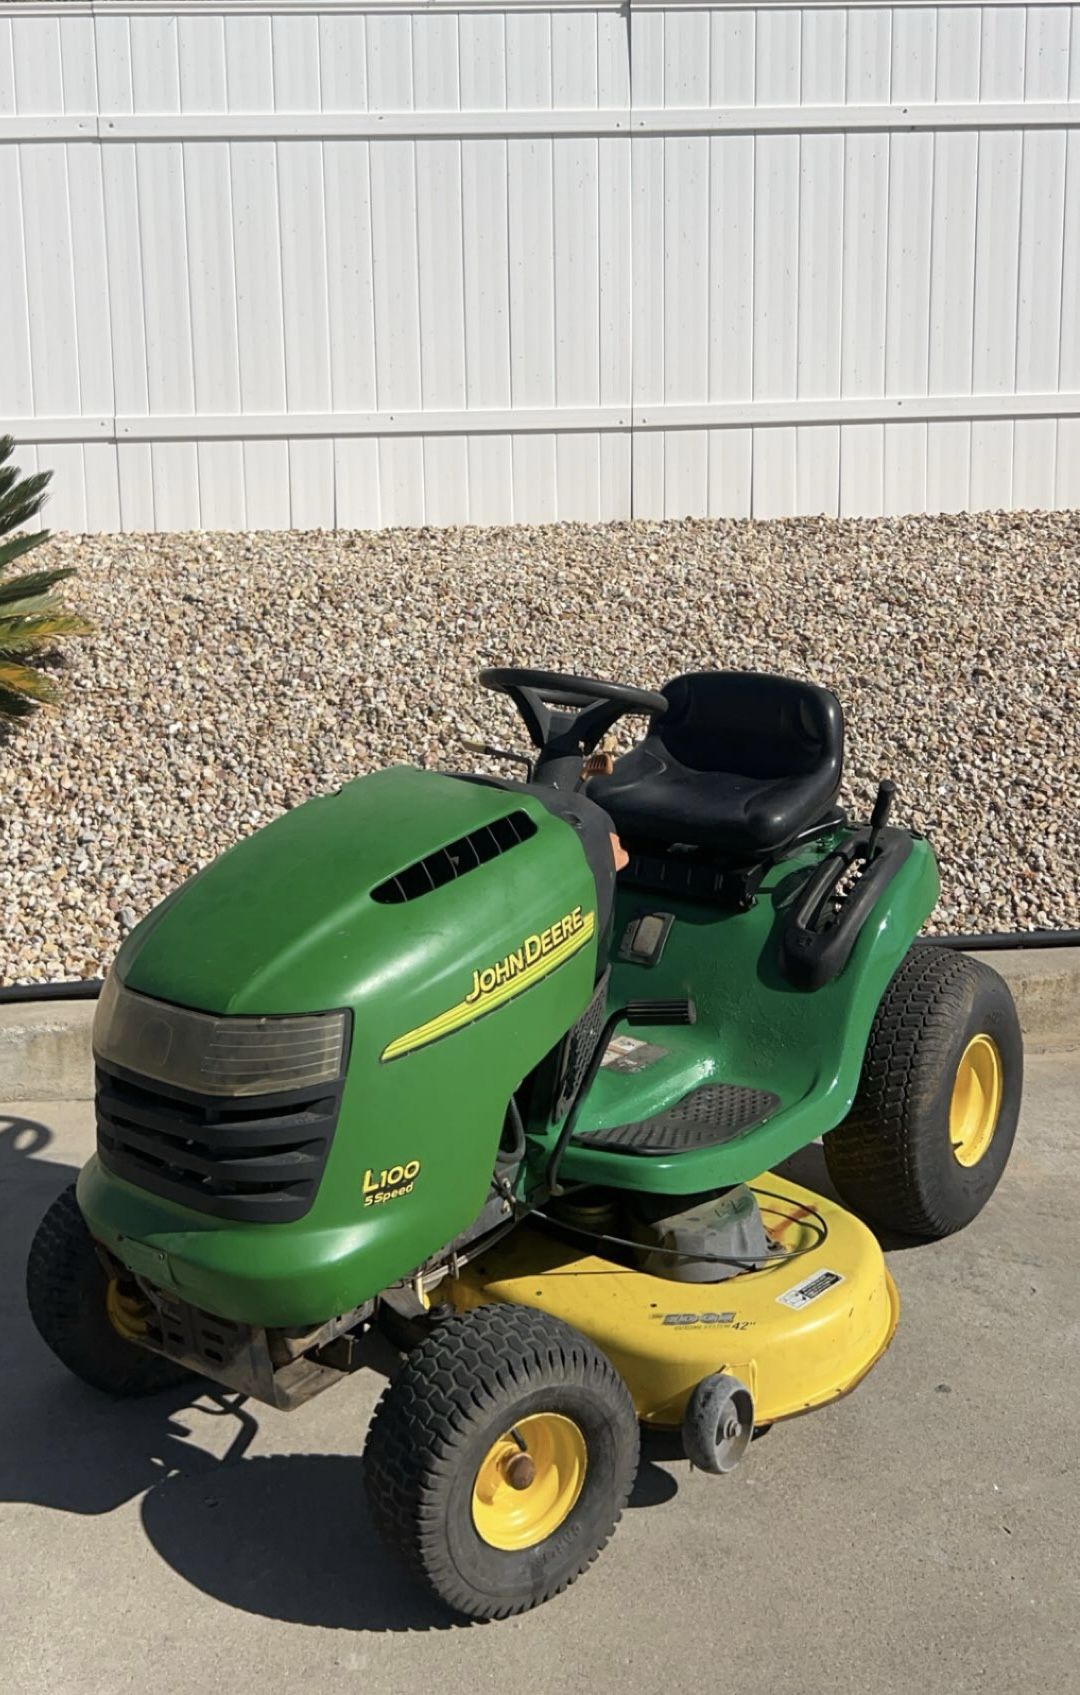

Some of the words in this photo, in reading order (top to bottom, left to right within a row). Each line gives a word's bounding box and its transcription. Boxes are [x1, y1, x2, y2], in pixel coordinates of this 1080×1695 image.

[466, 948, 524, 1003] JOHN
[524, 905, 583, 966] DEERE
[363, 1160, 420, 1193] L100
[364, 1195, 374, 1206] 5
[374, 1182, 413, 1203] Speed
